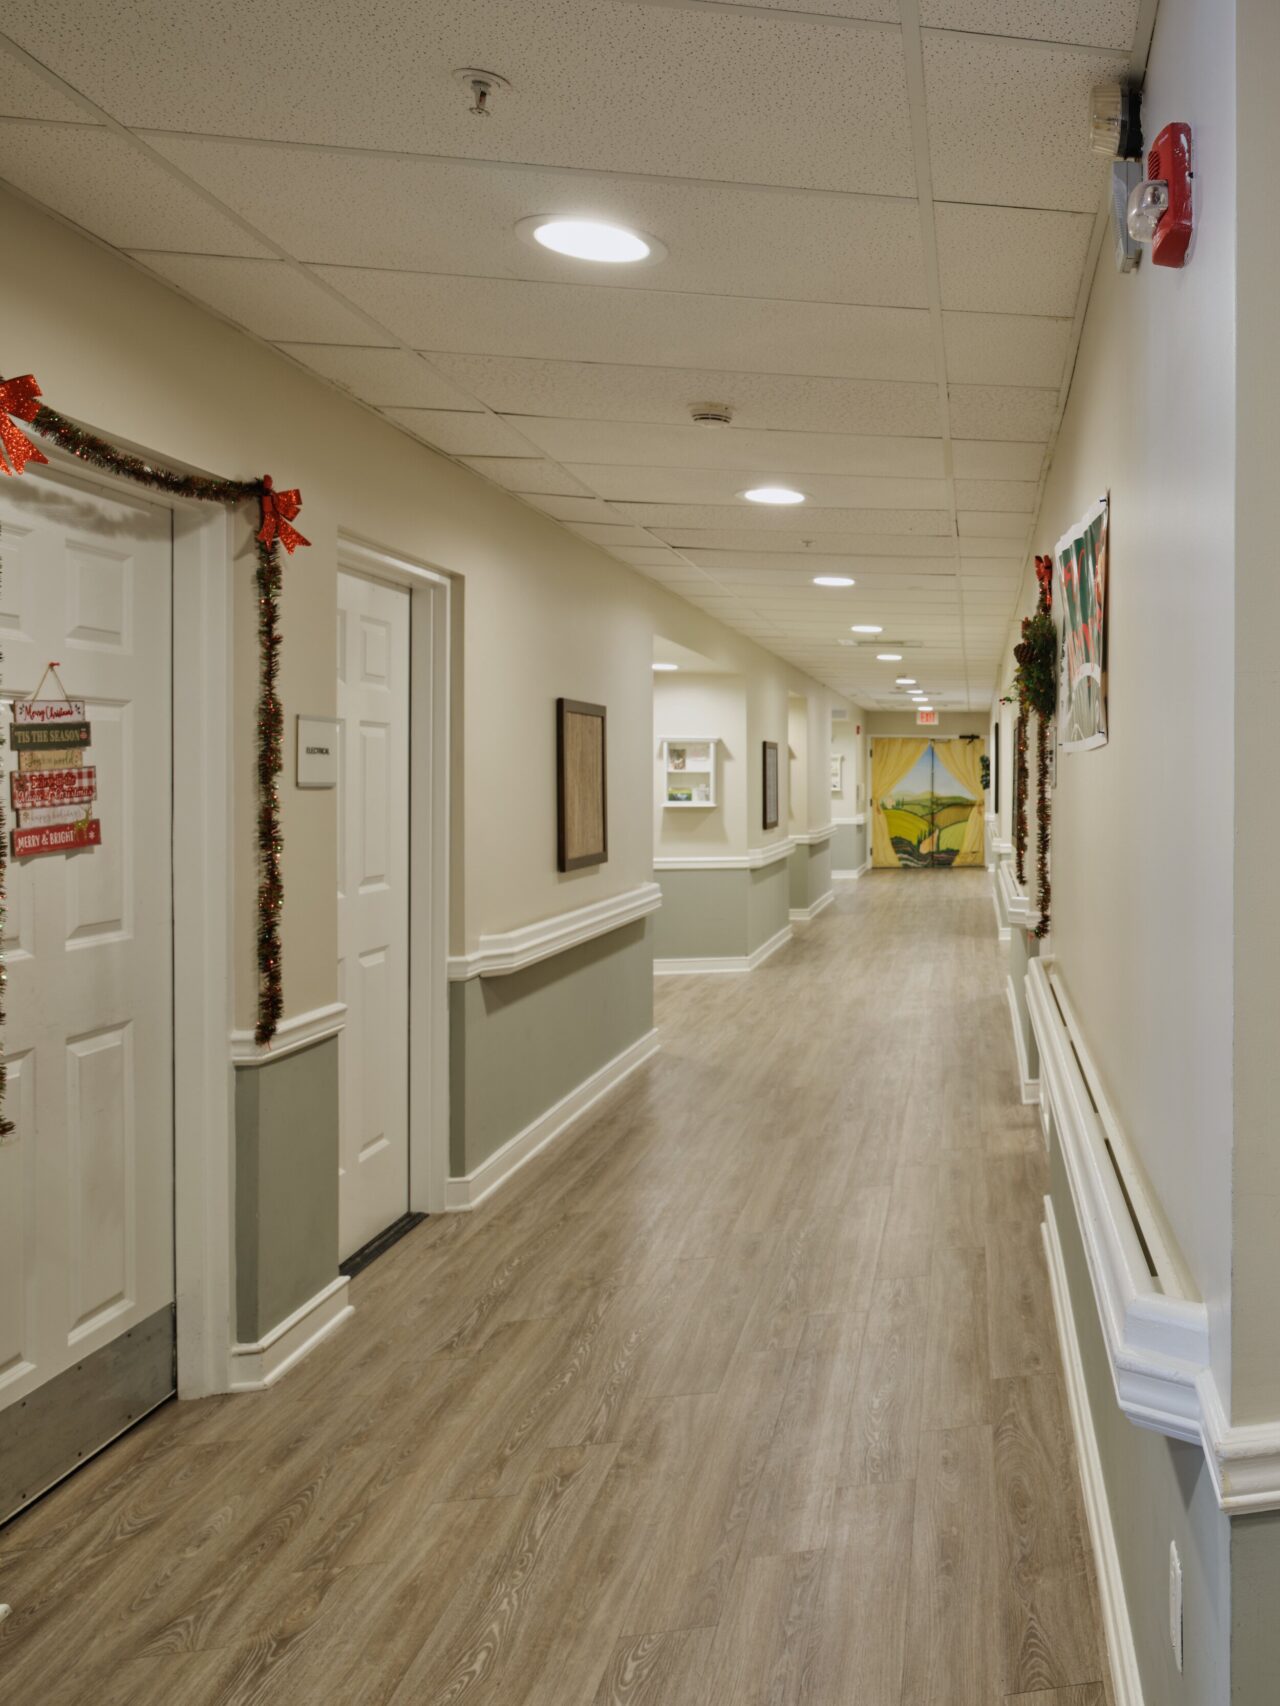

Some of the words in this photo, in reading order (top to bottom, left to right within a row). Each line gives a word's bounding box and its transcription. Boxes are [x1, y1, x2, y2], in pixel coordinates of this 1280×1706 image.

[25, 704, 45, 721] Merry
[920, 712, 935, 722] EXIT
[31, 730, 48, 742] THE
[49, 729, 79, 742] SEASON
[17, 834, 40, 849] MERRY
[41, 833, 48, 845] &
[49, 830, 74, 845] BRIGHT
